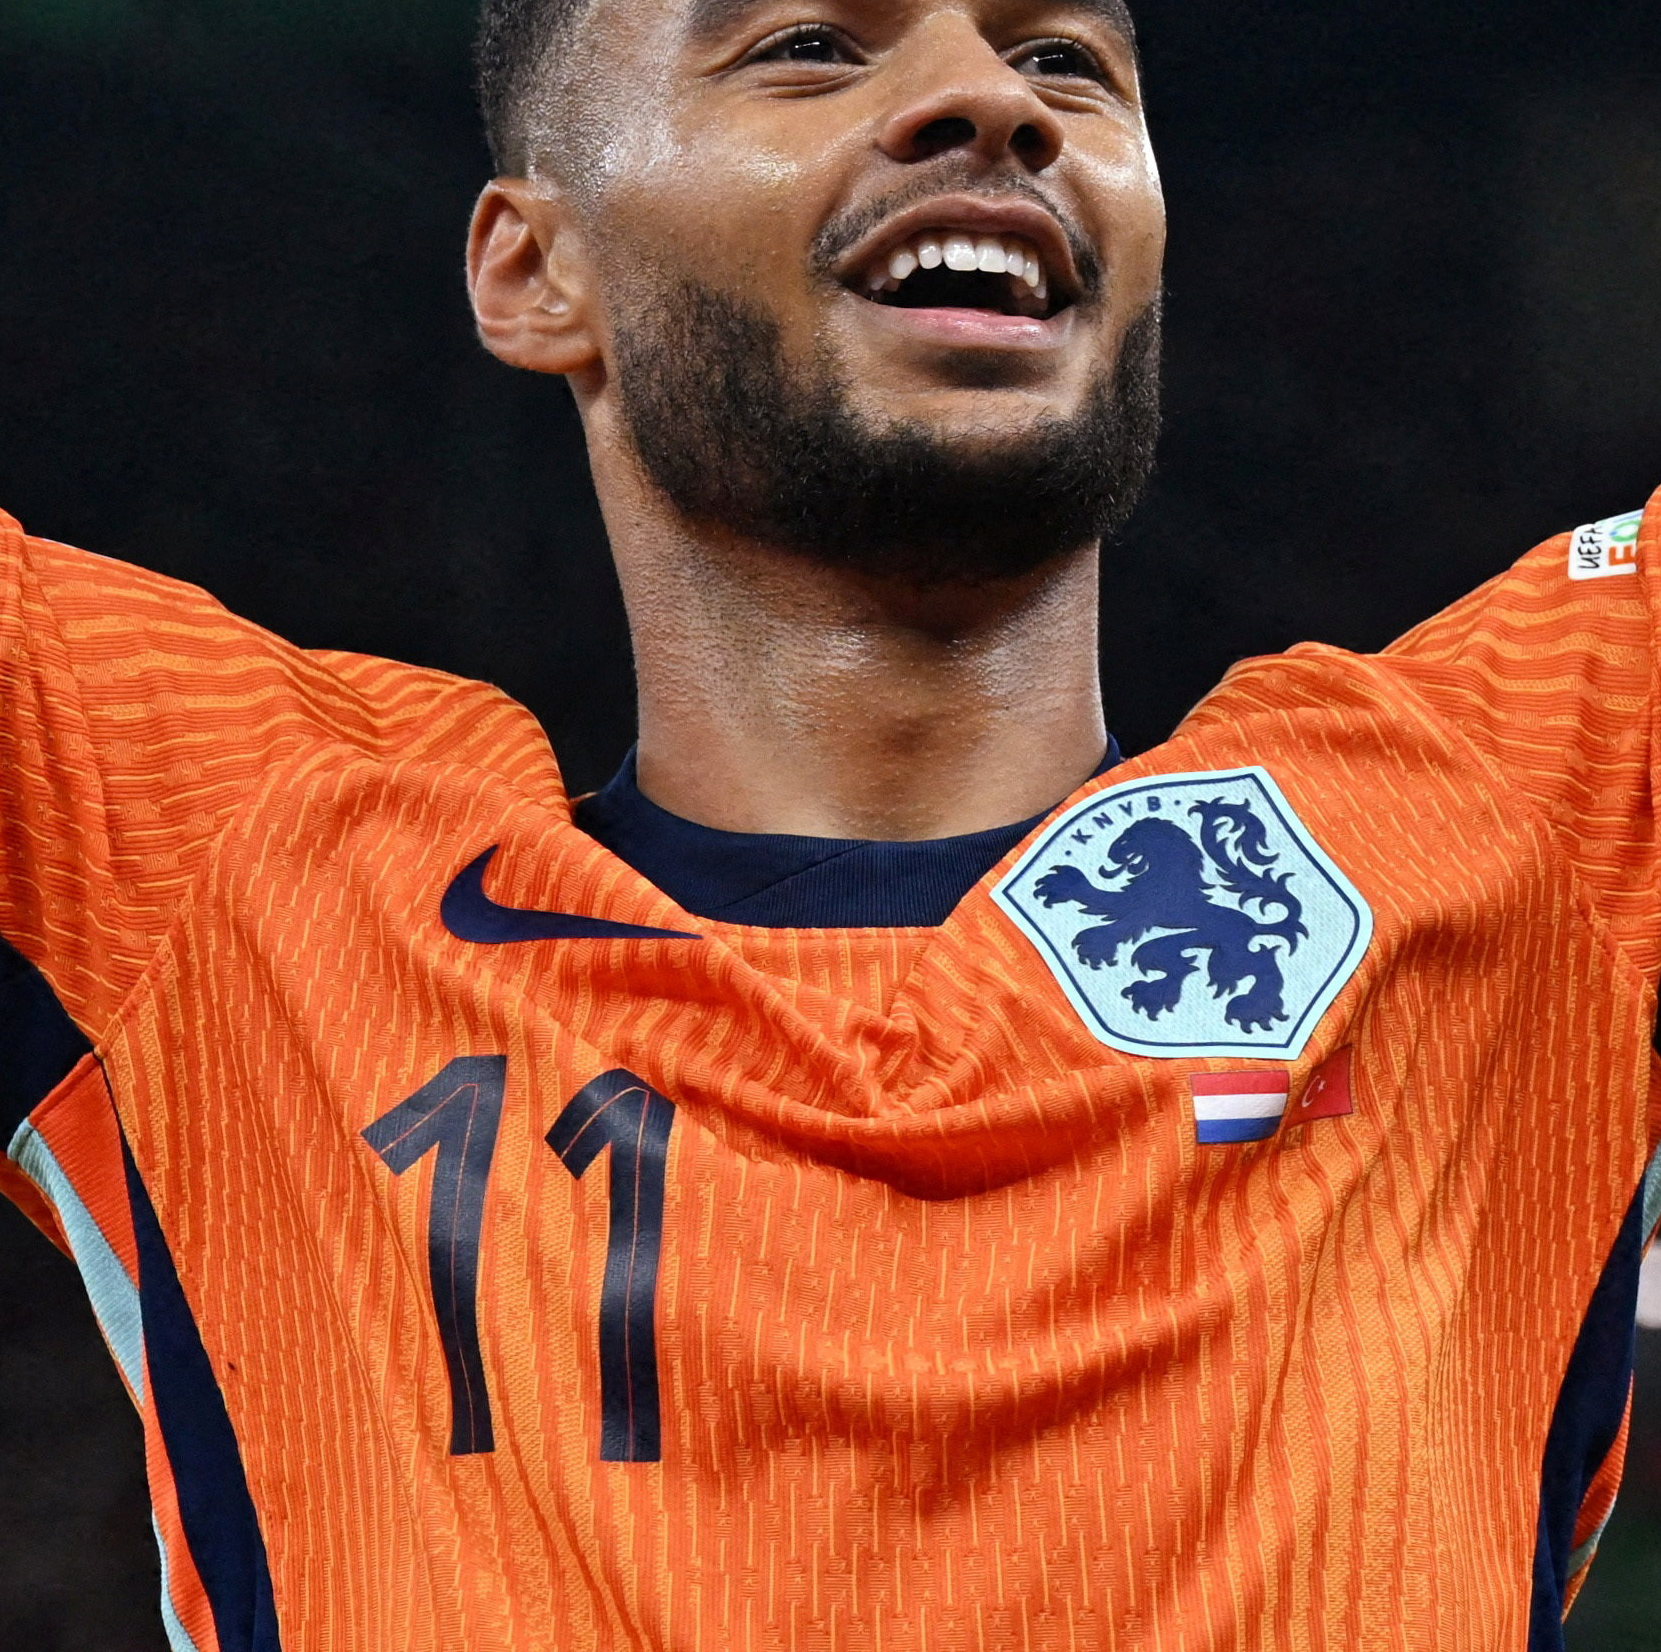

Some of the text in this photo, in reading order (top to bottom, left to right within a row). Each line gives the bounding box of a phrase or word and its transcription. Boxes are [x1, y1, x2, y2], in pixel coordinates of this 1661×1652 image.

[1577, 525, 1603, 569] UEFA
[1070, 795, 1162, 845] KNVB
[360, 1054, 676, 1462] 11
